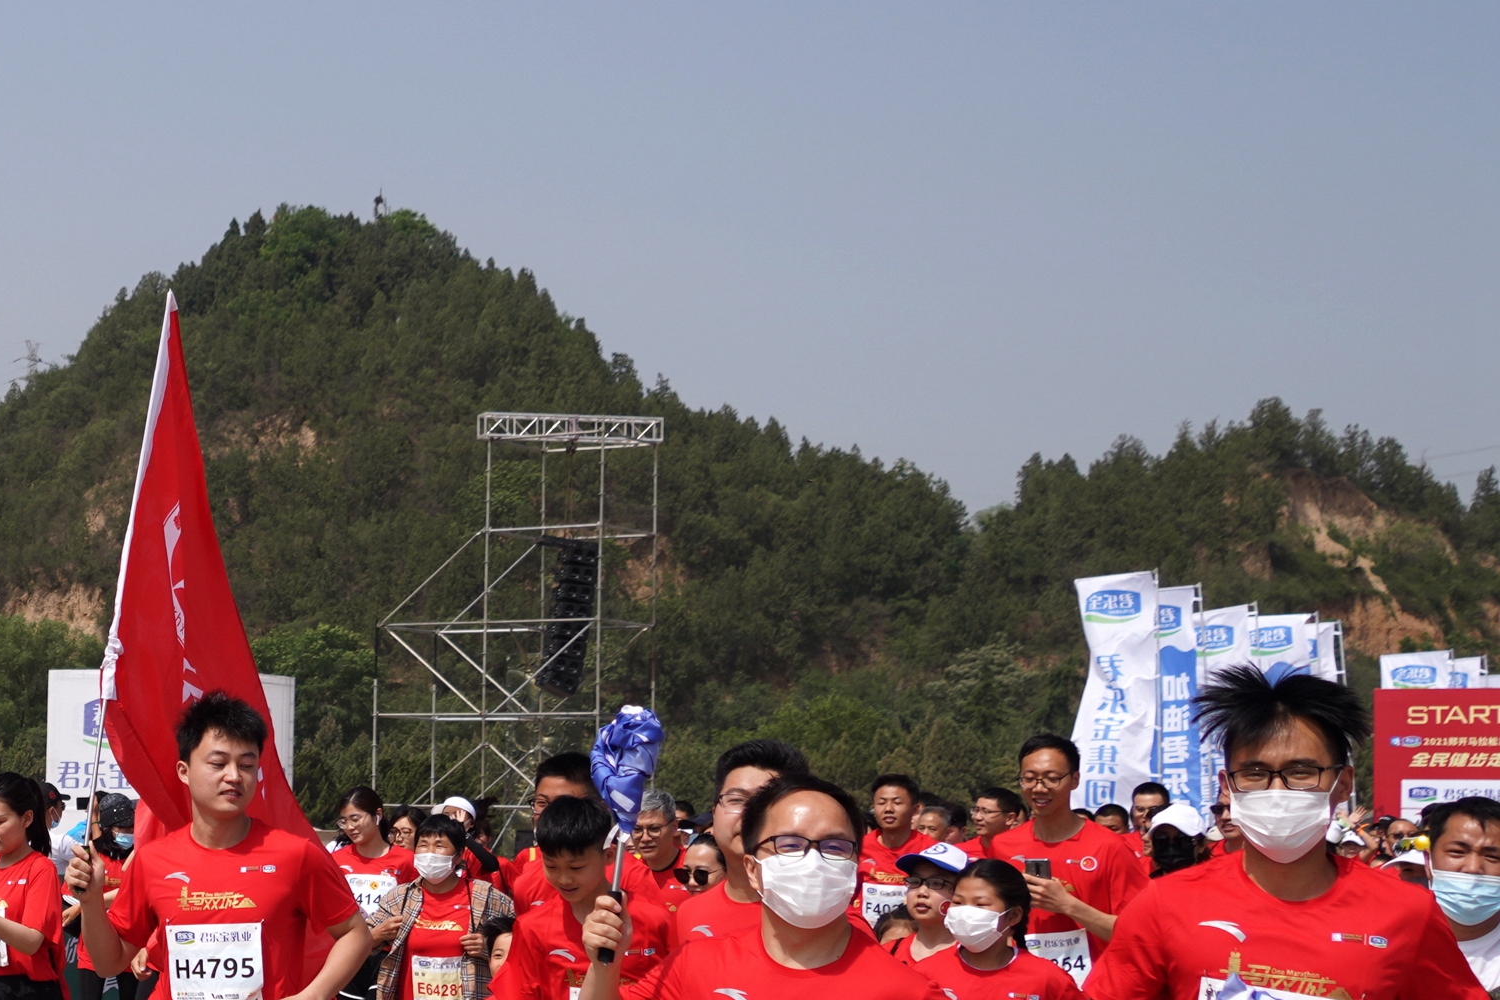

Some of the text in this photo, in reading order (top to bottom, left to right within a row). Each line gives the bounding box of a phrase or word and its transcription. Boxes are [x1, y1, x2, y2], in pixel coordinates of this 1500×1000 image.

[1422, 736, 1500, 747] 2021郑开马拉松
[199, 930, 252, 944] 君乐宝乳业
[175, 957, 255, 980] H4795
[1271, 967, 1320, 979] One Marathon
